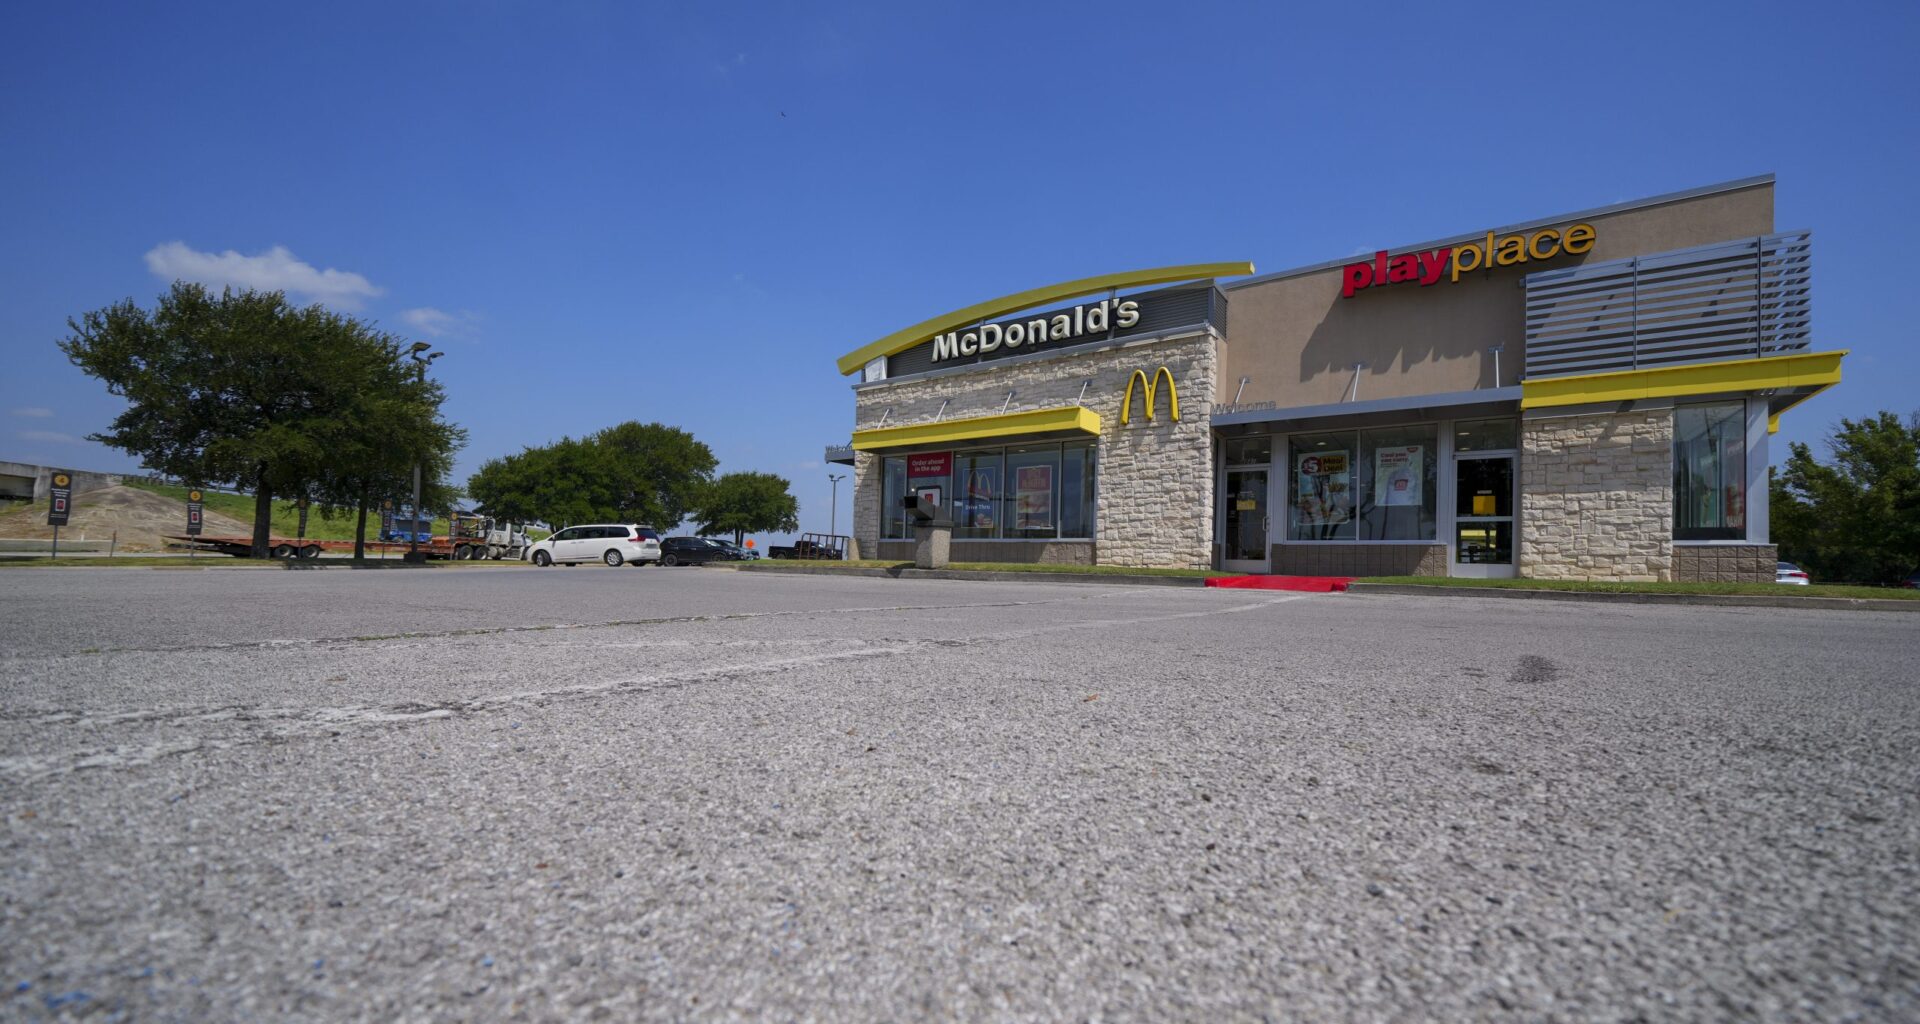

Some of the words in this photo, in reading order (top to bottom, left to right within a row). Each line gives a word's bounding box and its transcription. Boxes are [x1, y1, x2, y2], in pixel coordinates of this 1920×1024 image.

[1343, 223, 1597, 298] playplace
[931, 298, 1140, 362] McDonald's
[1322, 456, 1344, 464] Meal
[1323, 464, 1344, 472] Deal
